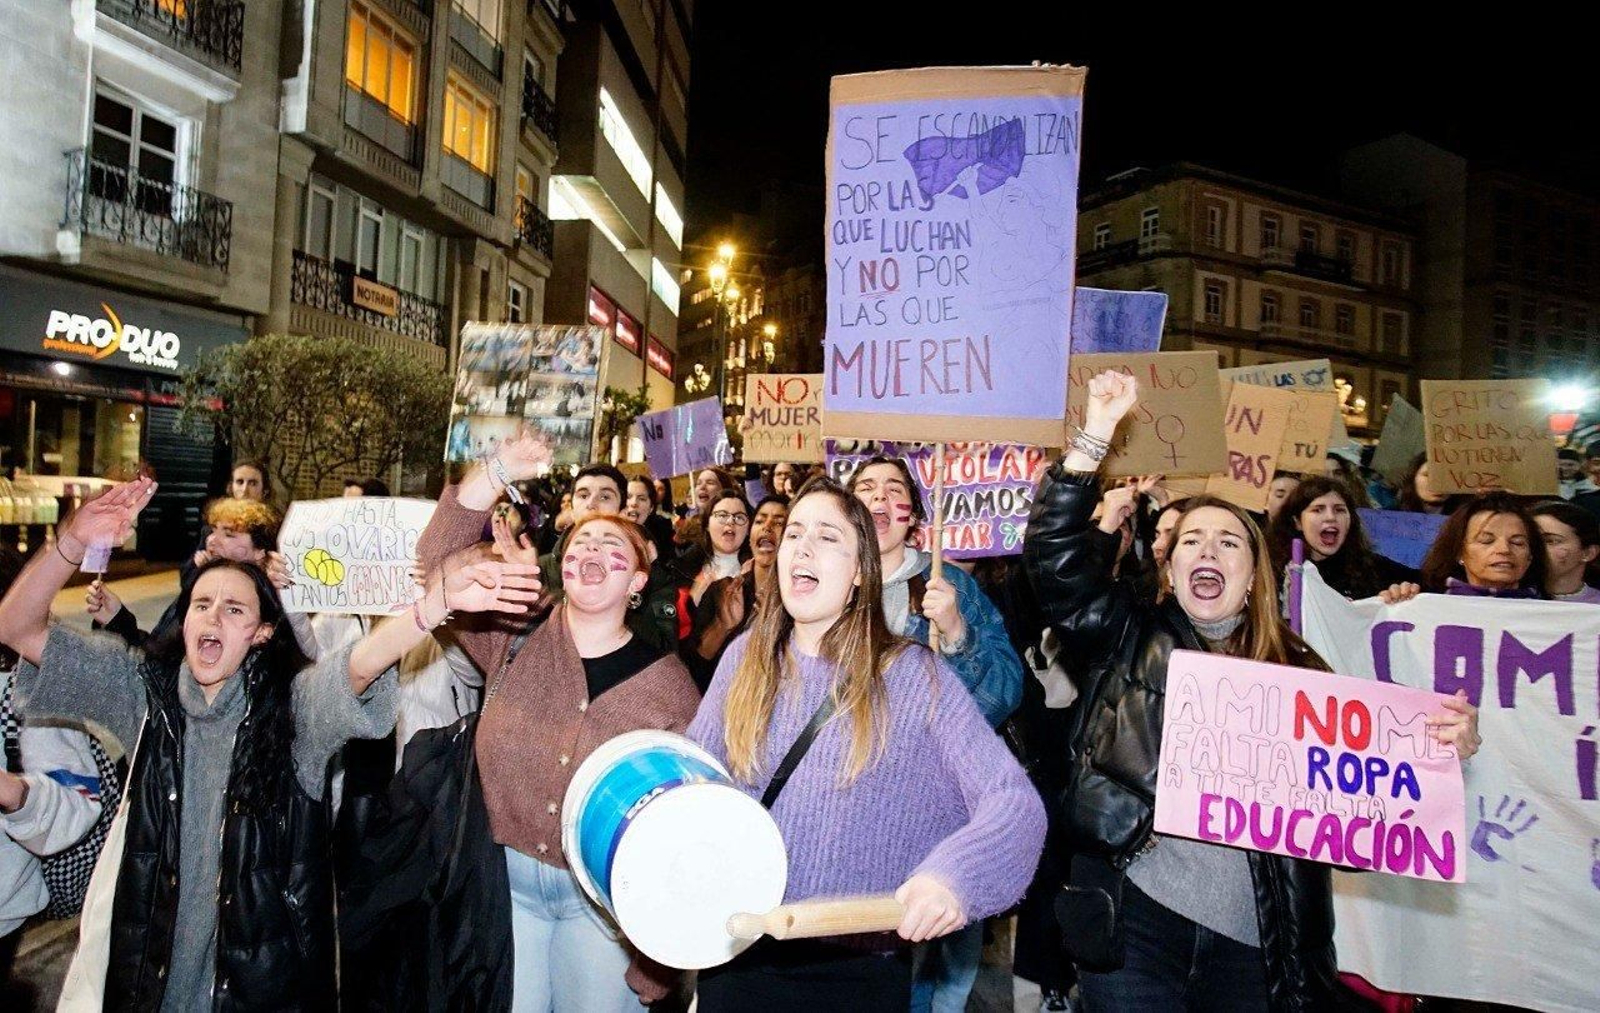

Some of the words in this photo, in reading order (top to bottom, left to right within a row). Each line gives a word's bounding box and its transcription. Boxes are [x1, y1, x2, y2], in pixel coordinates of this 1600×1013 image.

[841, 115, 898, 170] SE
[915, 110, 1079, 162] ESCANDALIZAN
[837, 181, 882, 216] POR
[887, 176, 935, 212] LAS
[833, 218, 874, 246] QUE
[880, 218, 972, 253] LUCHAN
[834, 255, 853, 295] Y
[859, 256, 900, 294] NO
[916, 254, 970, 288] POR
[840, 299, 888, 327] LAS
[901, 295, 959, 326] QUE
[830, 334, 993, 400] MUEREN
[757, 376, 809, 405] NO
[750, 406, 822, 427] MUJER
[1432, 423, 1471, 444] POR
[1476, 422, 1512, 441] LAS
[916, 448, 1042, 489] VIOLAR
[1433, 448, 1459, 466] NO
[1450, 470, 1502, 489] VOZ
[343, 500, 397, 526] HASTA
[325, 523, 420, 561] OVARIO
[289, 584, 347, 606] TANTOS
[1371, 620, 1600, 717] COM
[1169, 673, 1206, 724] A
[1214, 676, 1281, 737] MI
[1293, 689, 1372, 751] NO
[1377, 704, 1455, 760] ME
[1166, 723, 1298, 787] FALTA
[1306, 745, 1422, 802] ROPA
[1164, 762, 1183, 788] A
[1190, 767, 1224, 796] TI
[1231, 778, 1277, 805] TE
[1288, 786, 1388, 821] FALTA
[1197, 792, 1456, 881] EDUCACIÓN
